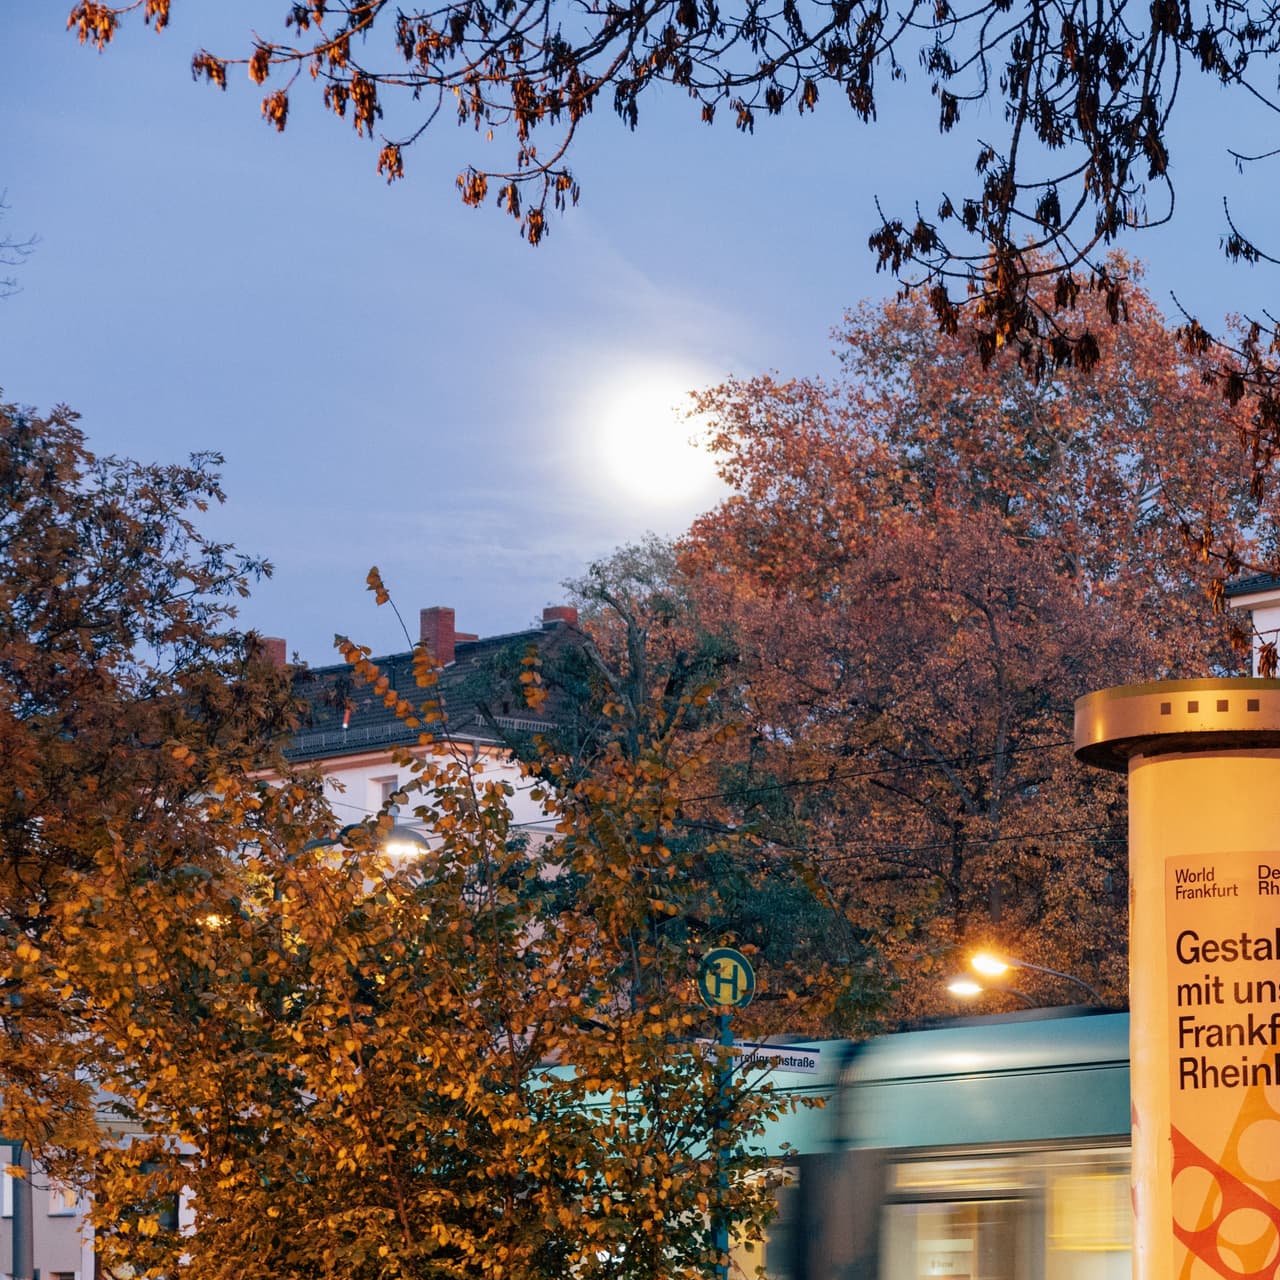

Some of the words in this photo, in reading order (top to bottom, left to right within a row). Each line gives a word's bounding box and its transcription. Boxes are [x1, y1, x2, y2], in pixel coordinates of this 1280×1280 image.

[1175, 867, 1215, 883] World
[1175, 883, 1239, 900] Frankfurt
[1177, 974, 1225, 1007] mit
